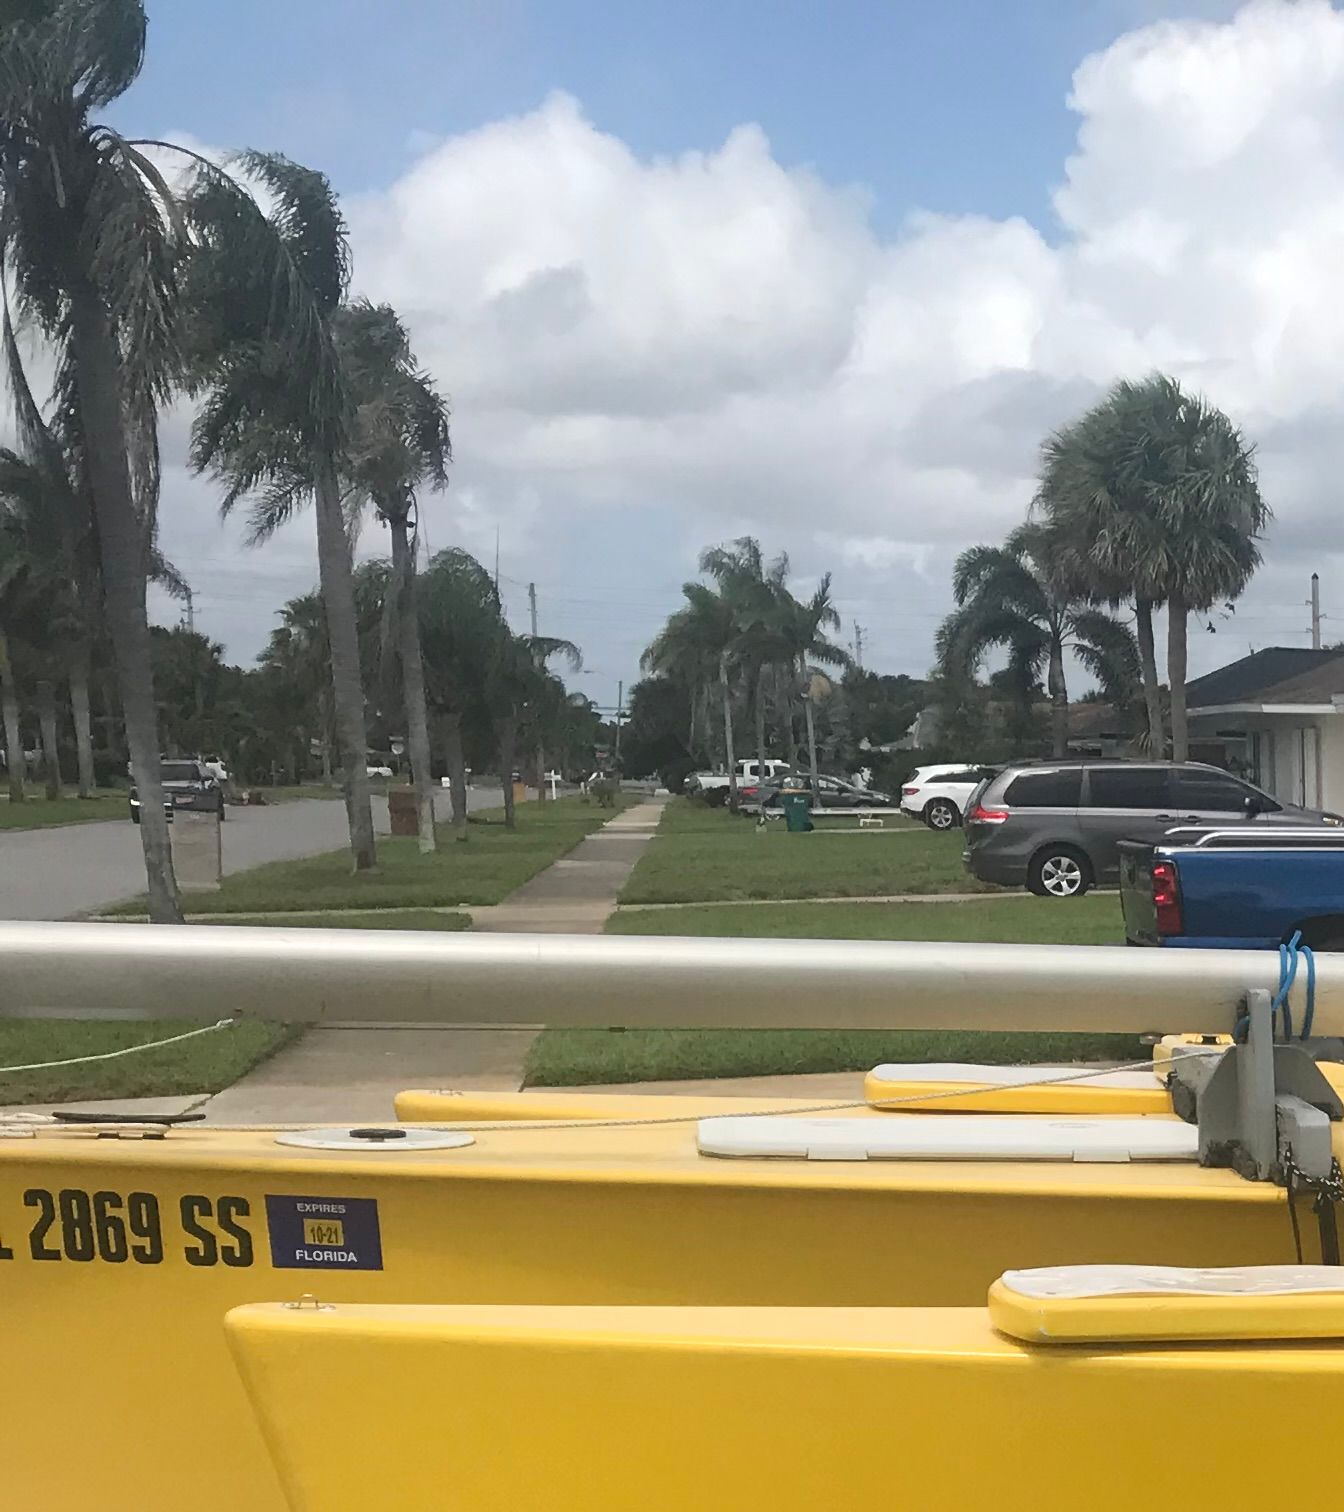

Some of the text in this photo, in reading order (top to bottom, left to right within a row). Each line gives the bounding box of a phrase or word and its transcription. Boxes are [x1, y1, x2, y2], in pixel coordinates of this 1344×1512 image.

[296, 1202, 346, 1214] EXPIRES
[23, 1188, 254, 1267] 2869 SS
[310, 1225, 339, 1244] 10-21
[295, 1249, 358, 1263] FLORIDA
